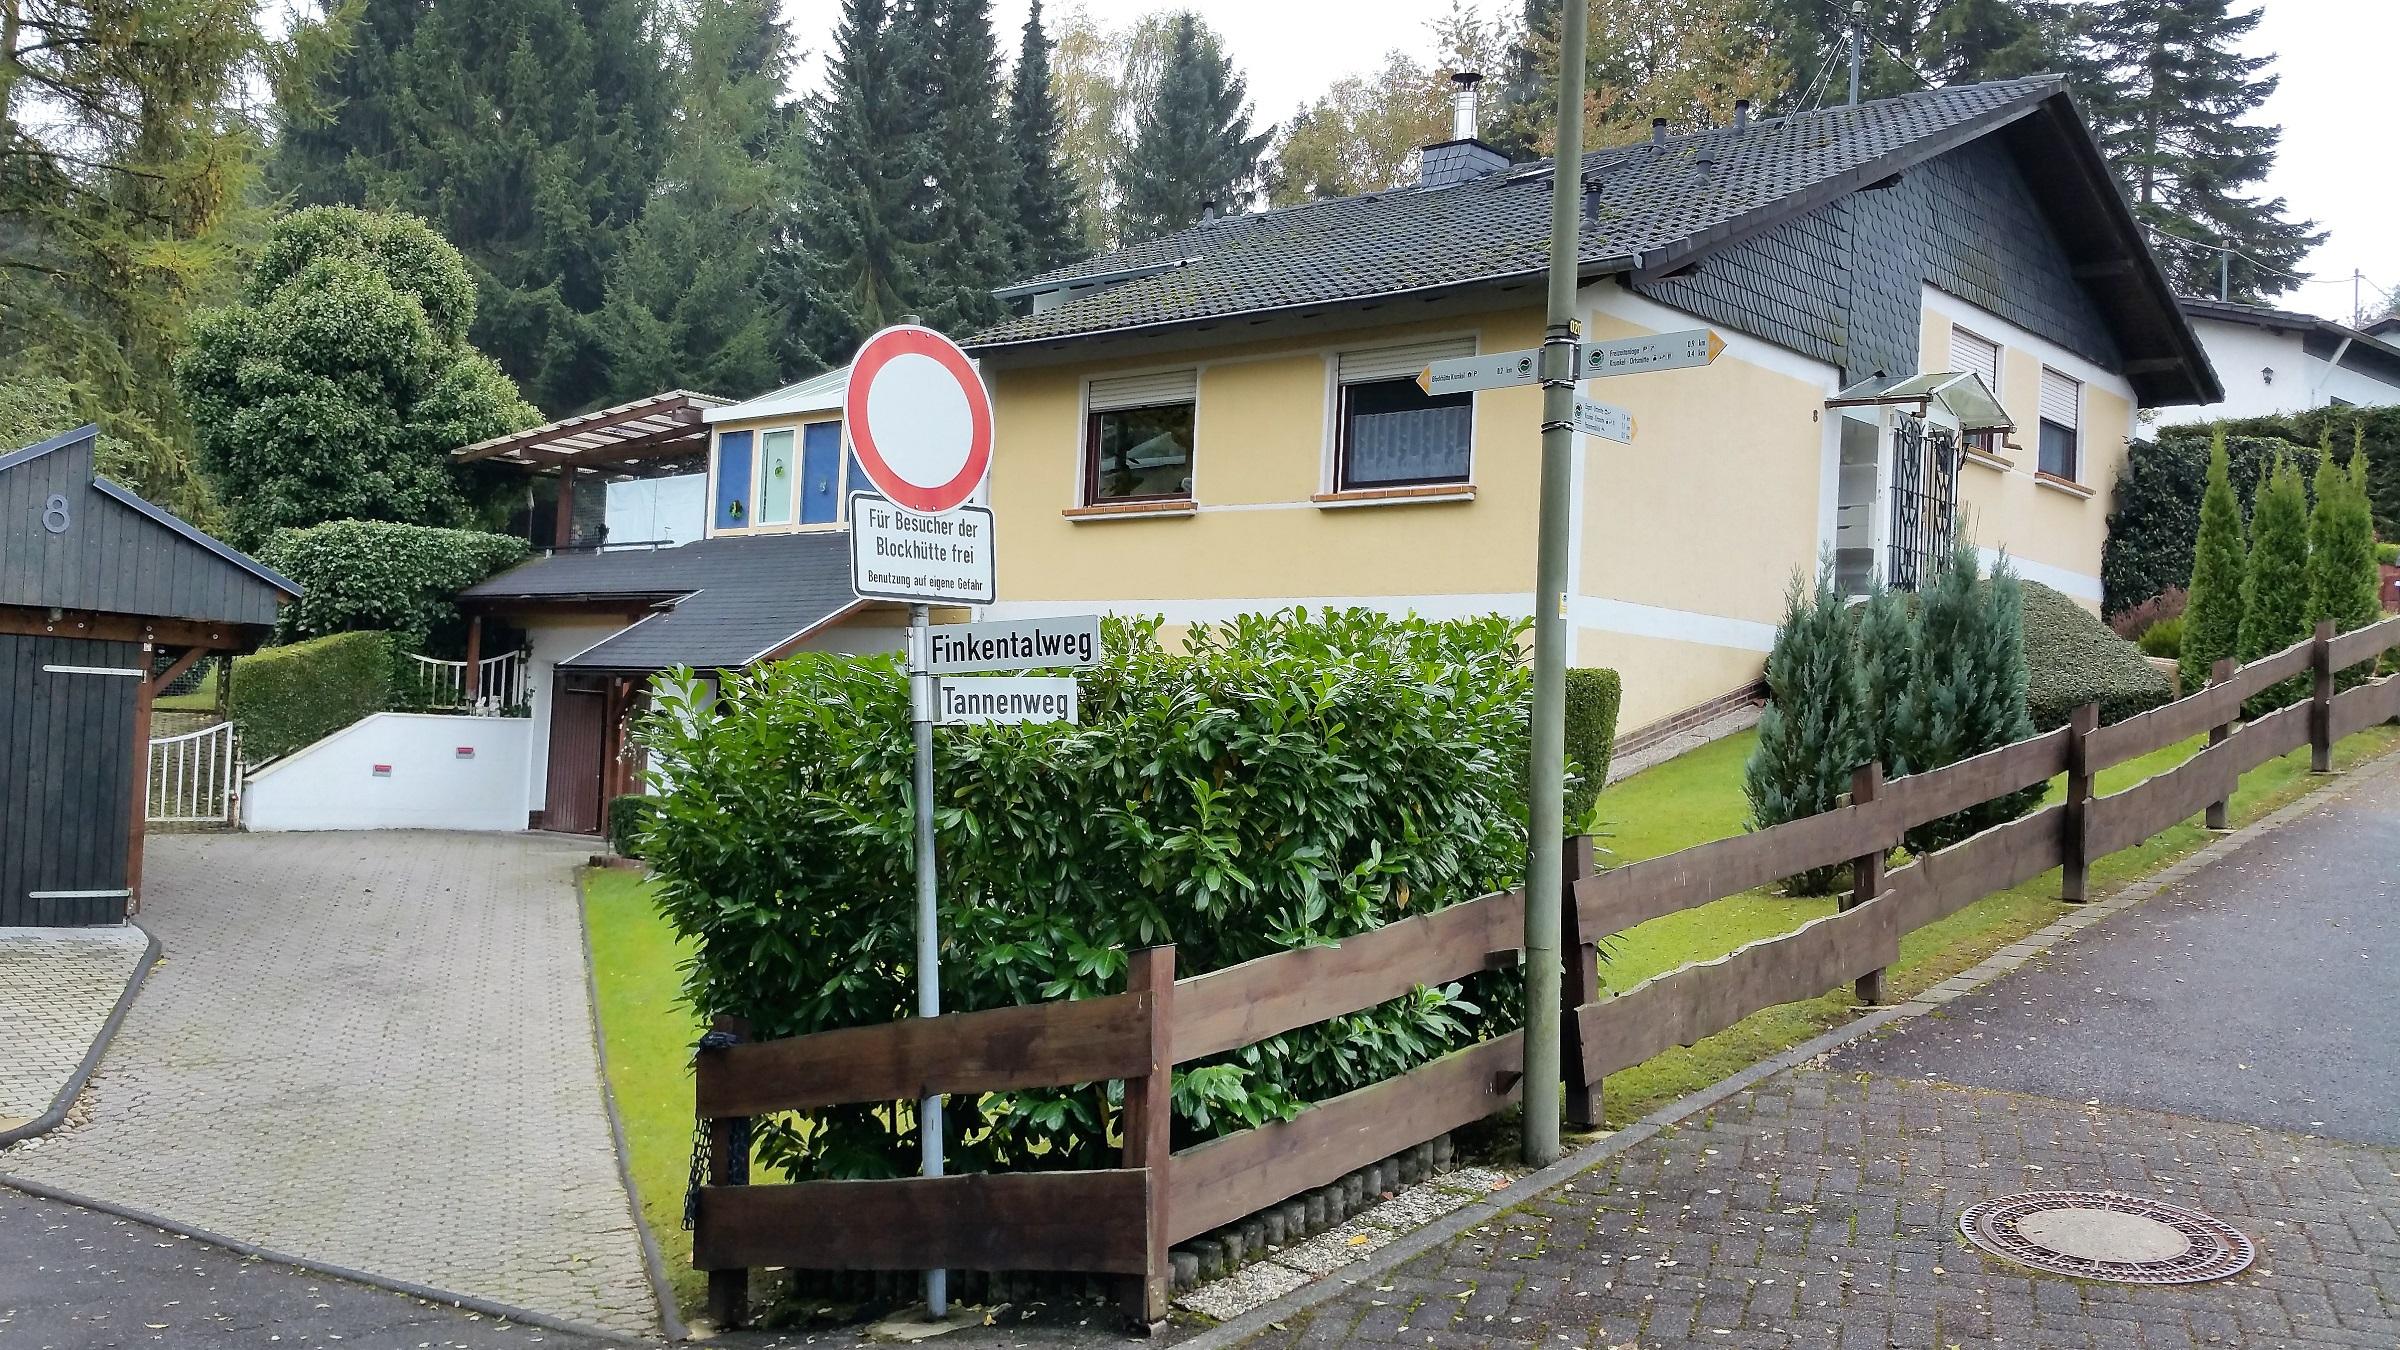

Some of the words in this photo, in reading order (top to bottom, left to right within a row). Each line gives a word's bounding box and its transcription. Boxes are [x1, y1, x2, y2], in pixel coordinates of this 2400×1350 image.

[1812, 409, 1819, 423] 8
[42, 494, 70, 533] 8
[869, 508, 890, 529] Für
[895, 511, 954, 536] Besucher
[958, 518, 978, 538] der
[876, 536, 947, 562] Blockhütte
[952, 544, 974, 564] frei
[868, 570, 911, 588] Benutzung
[914, 575, 927, 587] auf
[929, 576, 955, 591] eigene
[957, 578, 983, 592] Gefahr
[932, 628, 1092, 663] Finkentalweg
[942, 686, 1069, 721] Tannenweg
